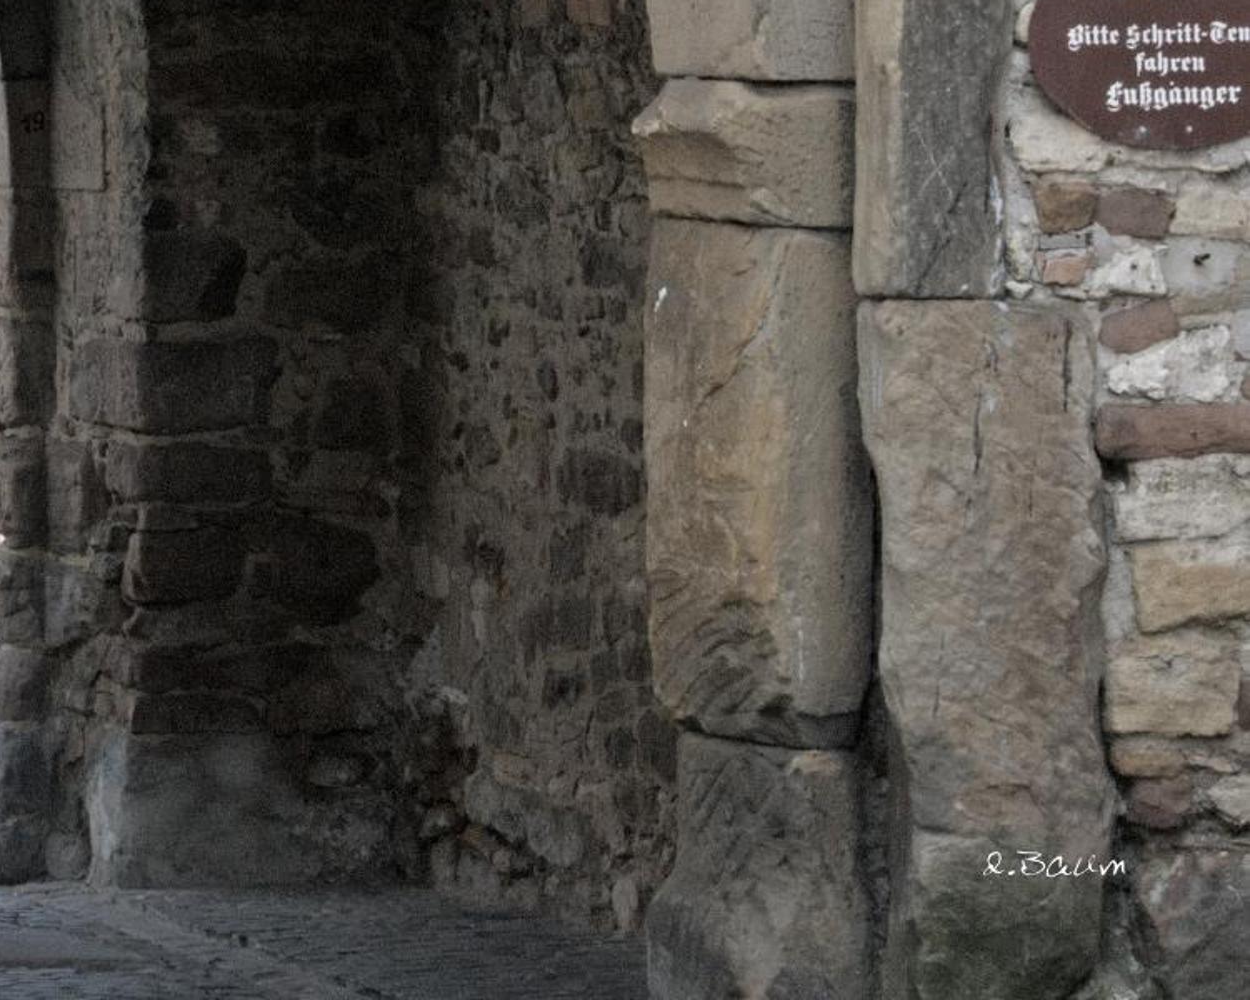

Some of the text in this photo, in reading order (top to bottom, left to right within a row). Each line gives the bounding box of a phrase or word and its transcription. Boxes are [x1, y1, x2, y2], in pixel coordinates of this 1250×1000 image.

[1067, 24, 1120, 50] Bitte
[1135, 52, 1205, 76] fahren
[1106, 81, 1241, 111] Fußgänger
